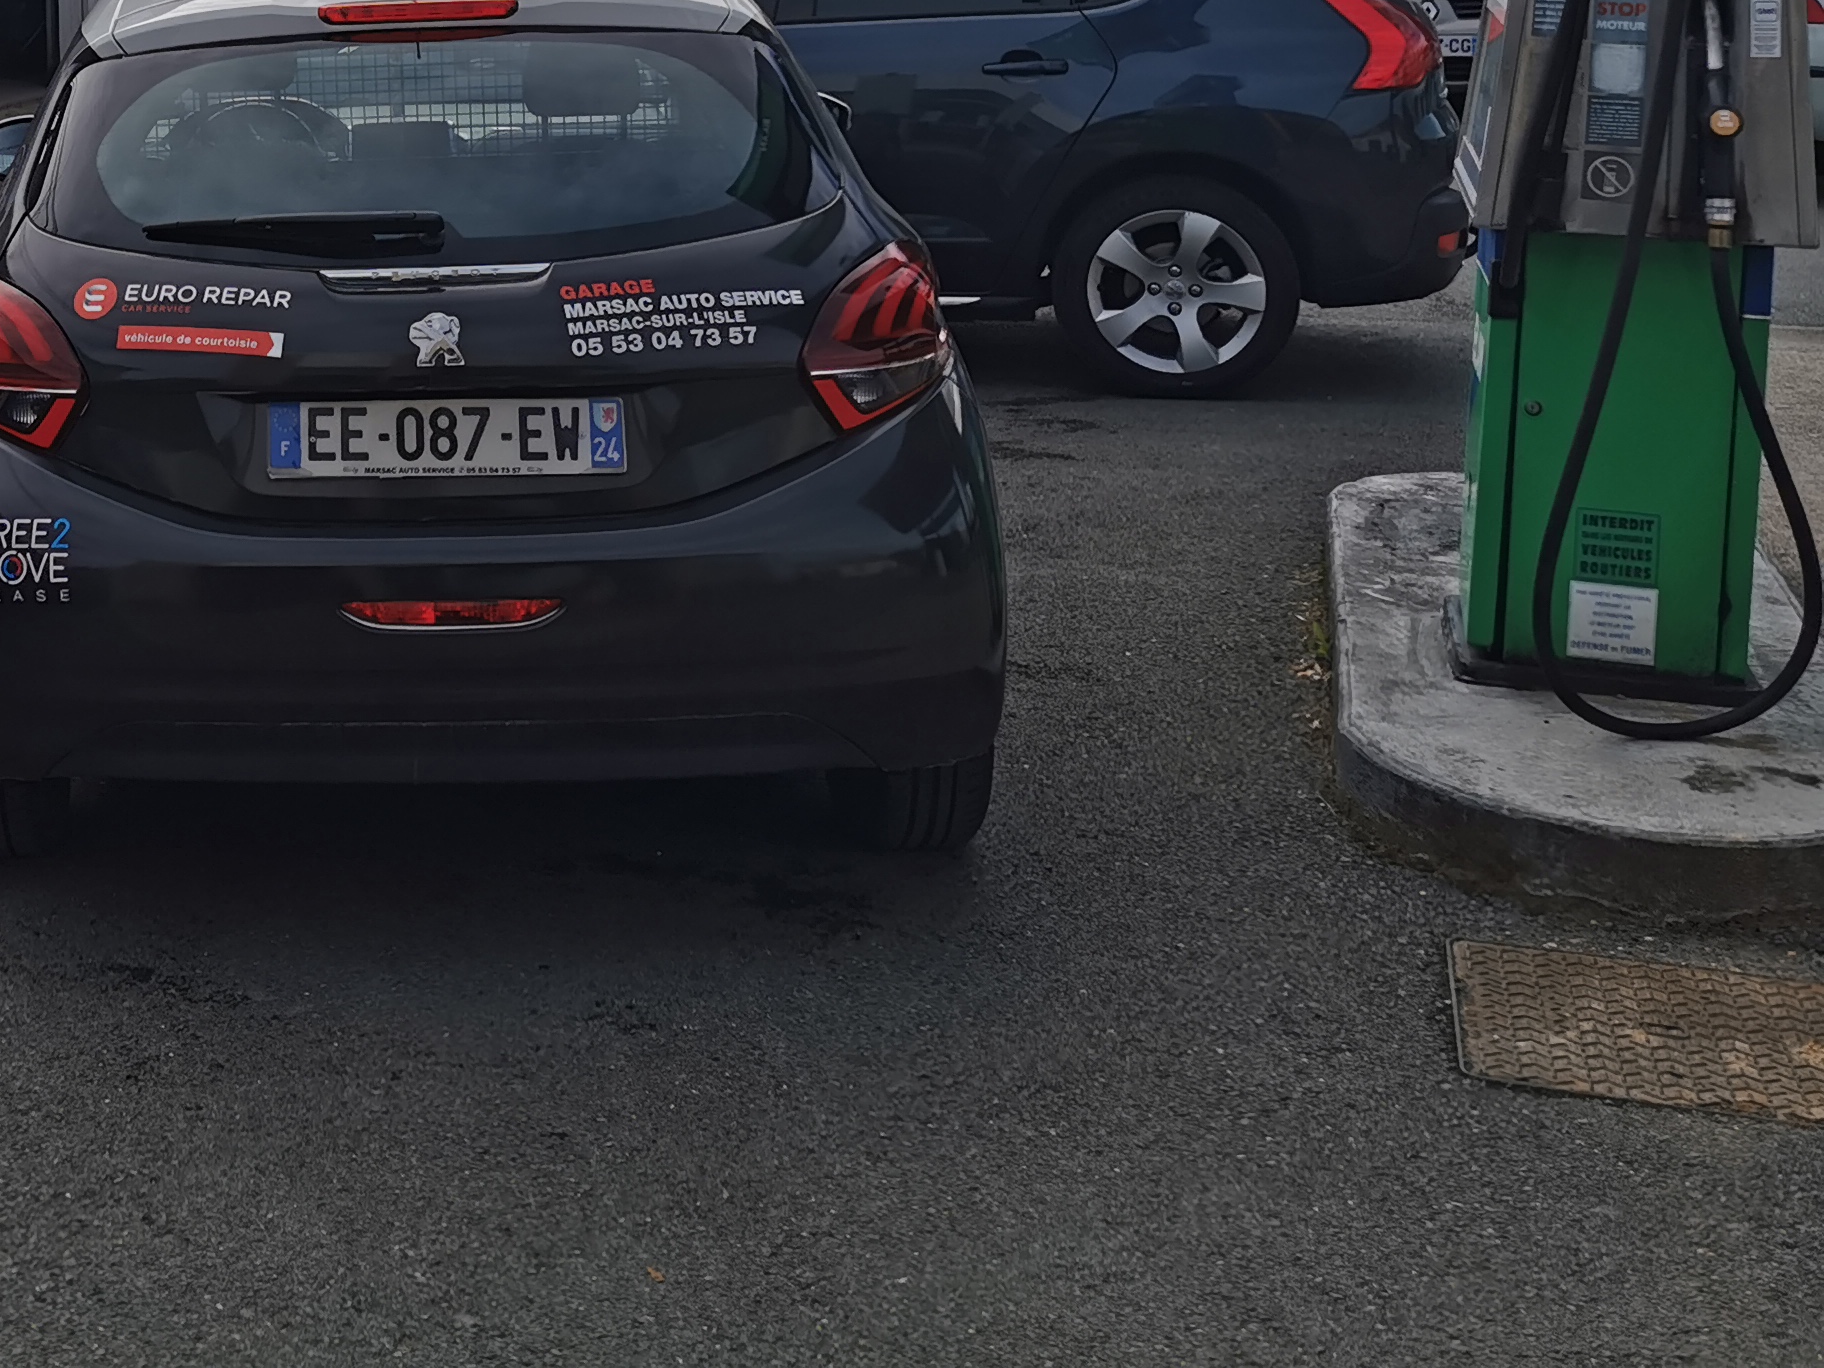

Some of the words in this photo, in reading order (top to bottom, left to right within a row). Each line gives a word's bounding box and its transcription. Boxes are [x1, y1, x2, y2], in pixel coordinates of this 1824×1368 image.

[1597, 1, 1647, 17] STOP
[1596, 19, 1648, 32] MOTEUR
[1439, 38, 1471, 53] -CG
[124, 284, 197, 304] EURO
[202, 286, 292, 309] REPAR
[559, 279, 657, 300] GARAGE
[121, 304, 143, 313] CAR
[146, 304, 192, 315] SERVICE
[563, 296, 654, 319] MARSAC
[659, 292, 716, 311] AUTO
[719, 289, 806, 308] SERVICE
[567, 309, 747, 336] MARSAC-SUR-L'ISLE
[124, 333, 174, 345] véhicule
[176, 334, 192, 345] de
[195, 335, 259, 350] courtoisie
[571, 338, 605, 357] 05
[610, 334, 645, 354] 53
[651, 330, 684, 350] 04
[690, 328, 722, 347] 73
[728, 325, 757, 345] 57
[307, 406, 580, 462] EE-087-EW
[280, 440, 291, 457] F
[593, 436, 621, 463] 24
[364, 466, 397, 475] MARSAC
[398, 466, 420, 475] AUTO
[421, 466, 455, 475] SERVICE
[1582, 513, 1655, 532] INTERDIT
[1581, 543, 1653, 563] VEHICULES
[1579, 560, 1652, 580] ROUTIERS
